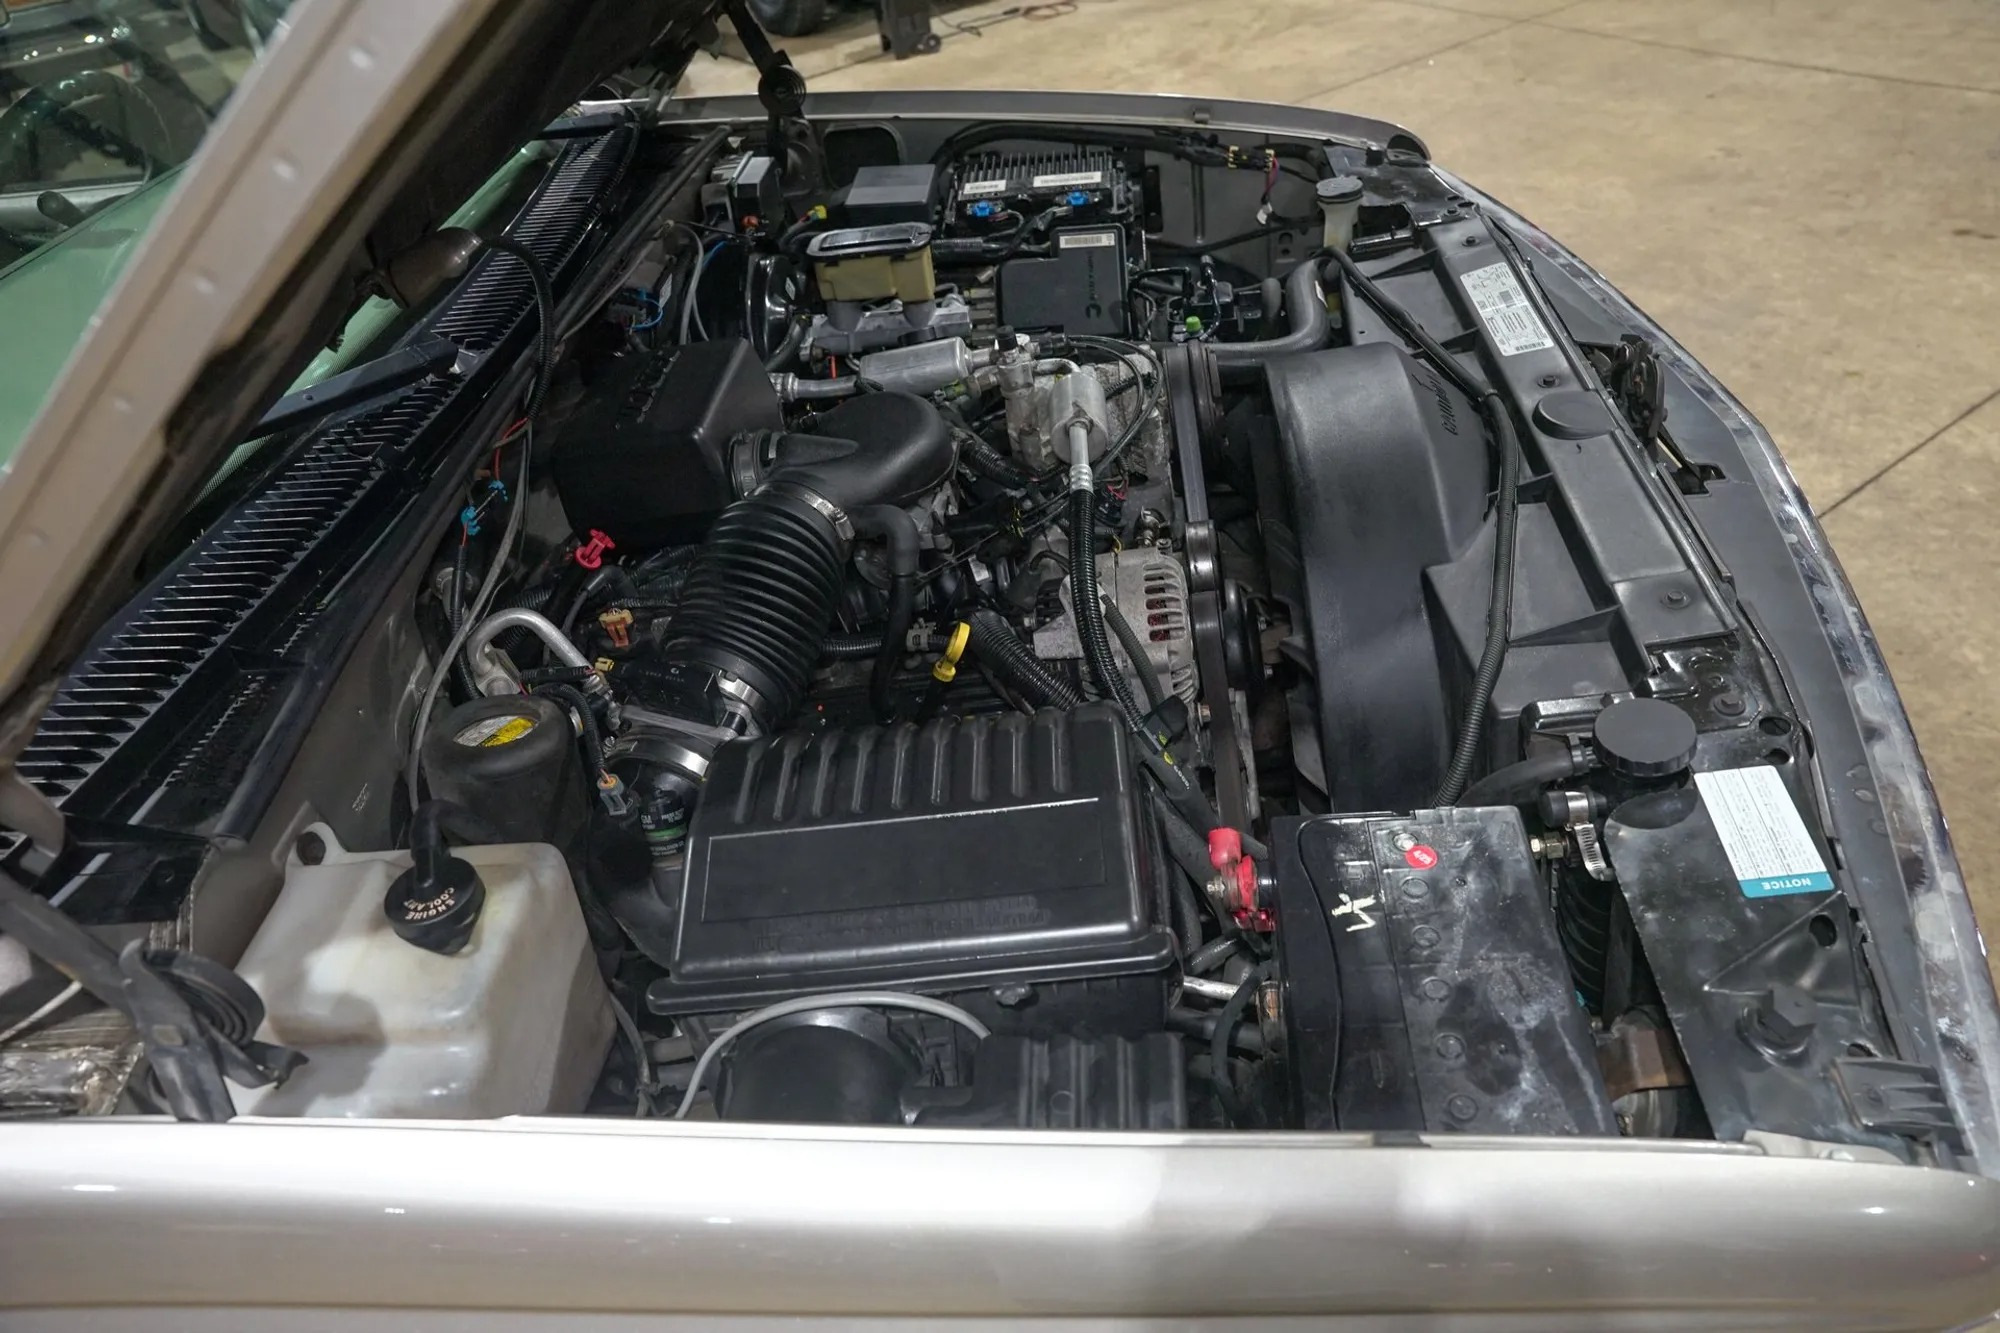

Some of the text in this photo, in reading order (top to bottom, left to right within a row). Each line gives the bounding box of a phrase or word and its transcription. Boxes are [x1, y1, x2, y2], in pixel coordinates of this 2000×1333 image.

[1761, 877, 1812, 890] NOTICE
[403, 887, 455, 911] COOLANT
[405, 899, 455, 920] ENGINE
